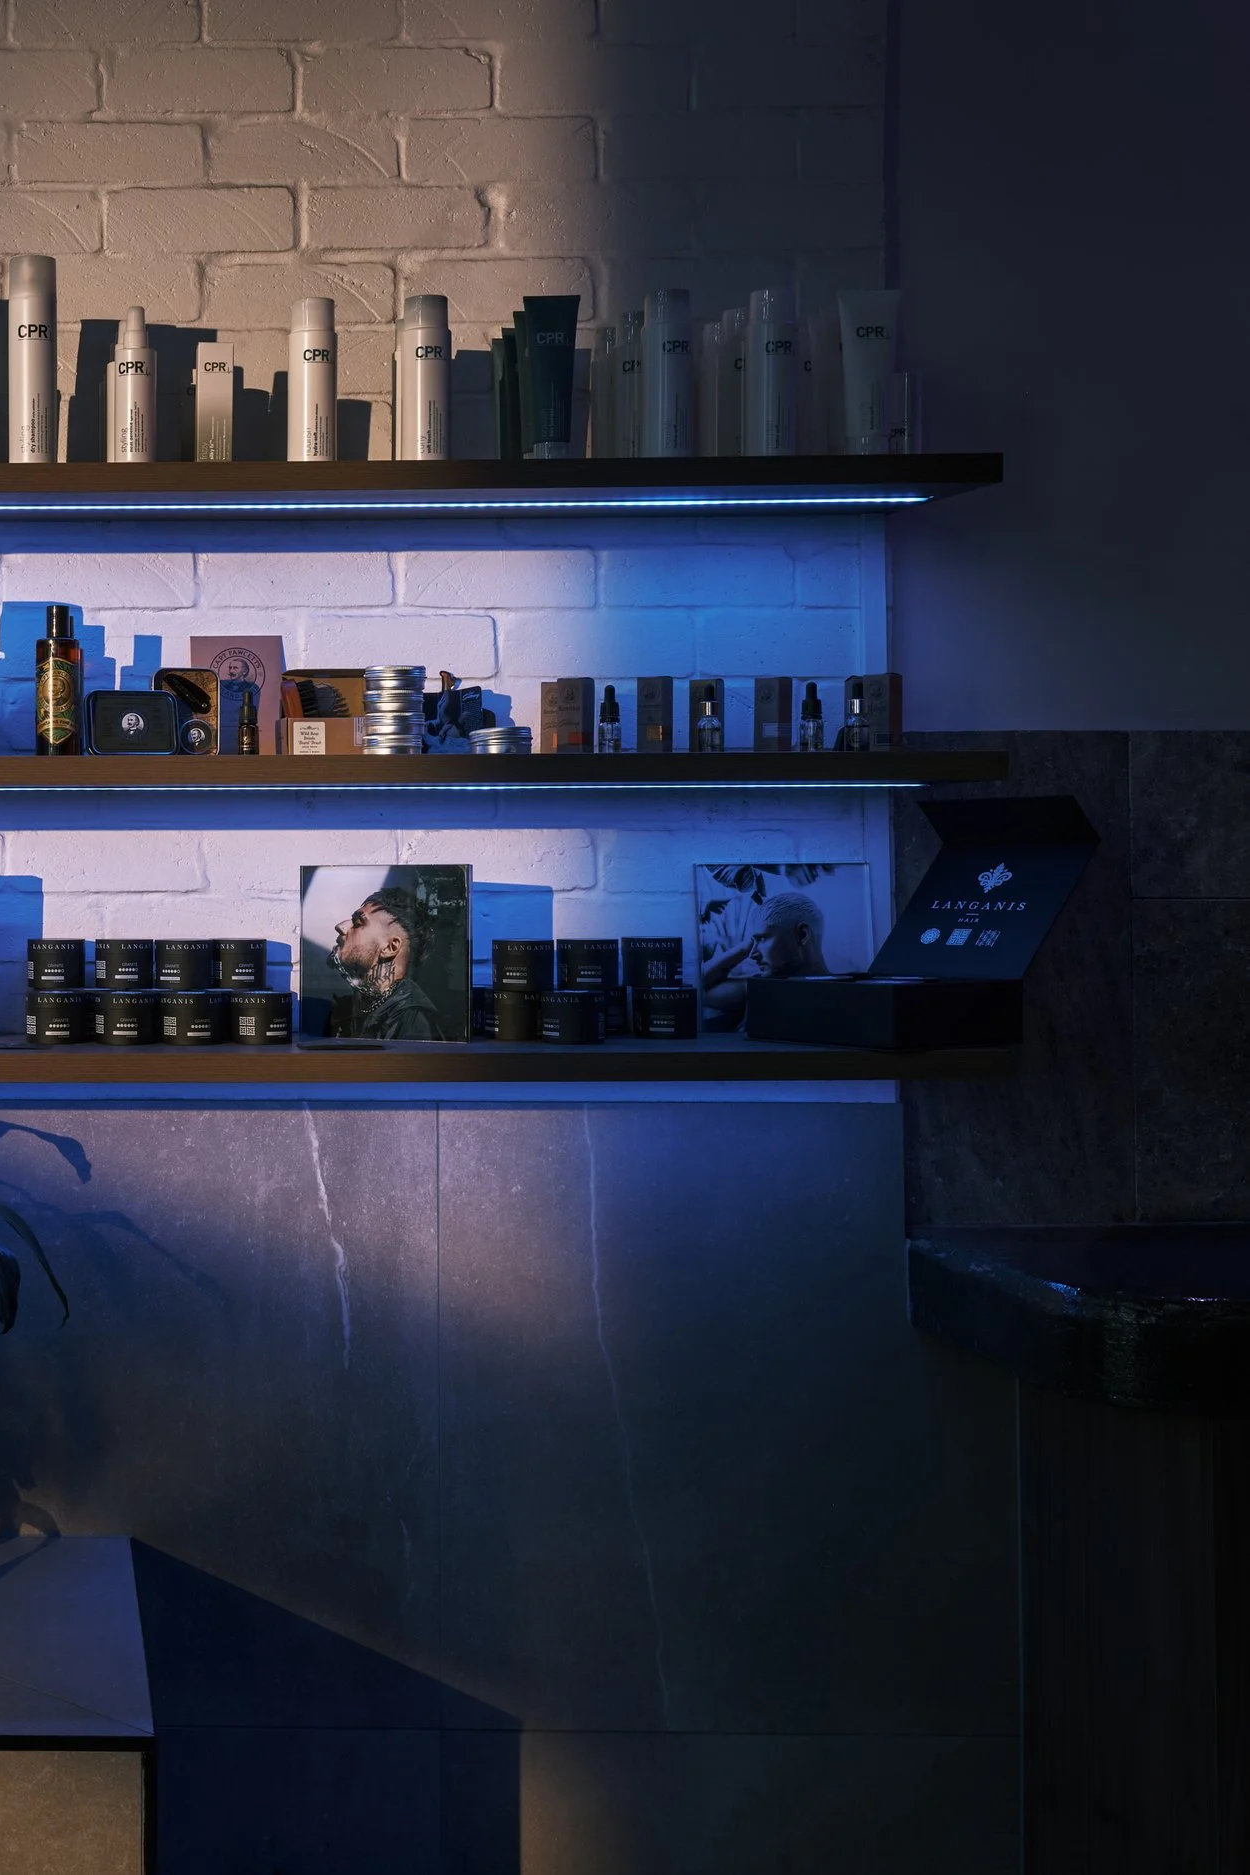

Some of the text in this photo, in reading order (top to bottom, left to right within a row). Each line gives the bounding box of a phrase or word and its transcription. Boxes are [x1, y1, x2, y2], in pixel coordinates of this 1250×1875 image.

[18, 324, 48, 339] CPR
[856, 325, 884, 338] CPR
[536, 332, 565, 345] CPR
[415, 346, 443, 359] CPR
[662, 340, 689, 354] CPR
[765, 340, 793, 354] CPR
[303, 349, 330, 362] CPR
[118, 360, 144, 375] CPR
[203, 360, 227, 373] CPR
[119, 427, 129, 453] styling
[212, 652, 227, 670] CAPT
[930, 899, 1028, 912] LANGANIS
